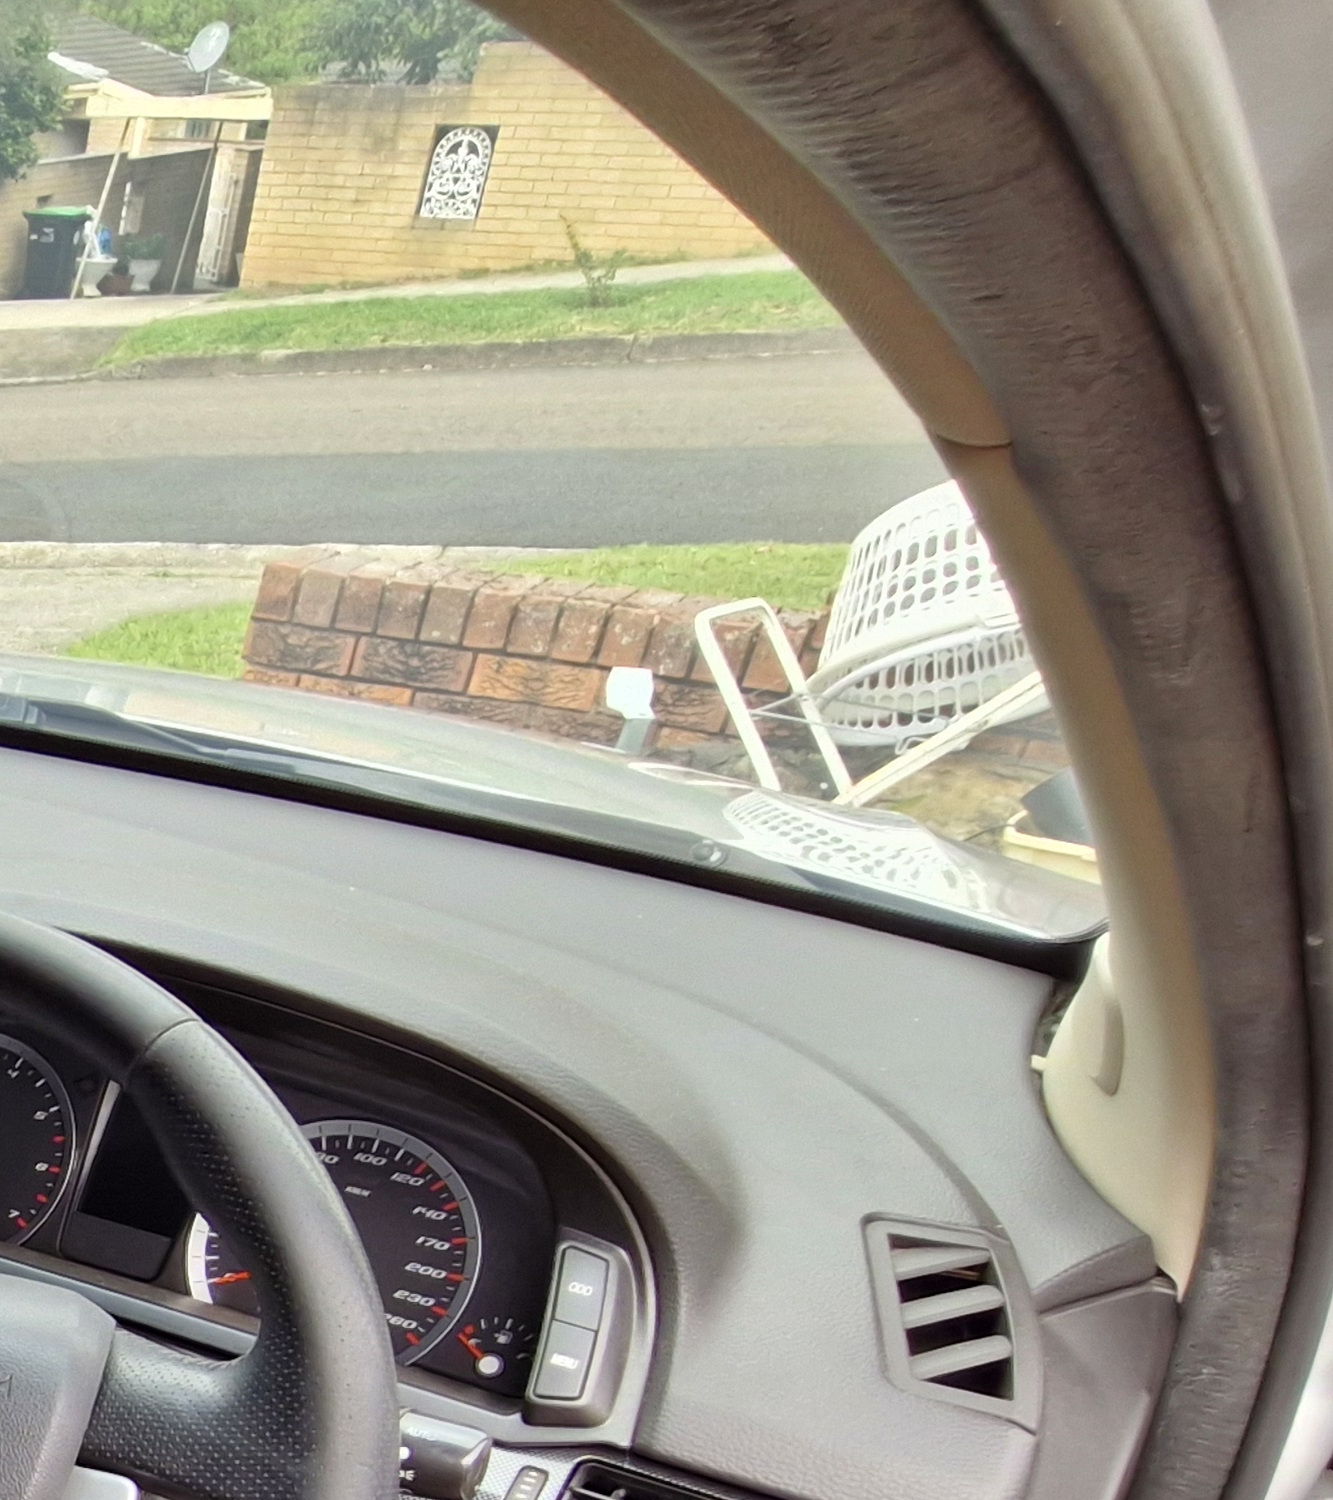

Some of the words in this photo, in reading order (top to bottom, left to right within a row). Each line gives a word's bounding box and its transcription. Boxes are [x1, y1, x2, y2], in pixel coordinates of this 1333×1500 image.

[353, 1152, 388, 1166] 100
[390, 1172, 425, 1186] 120
[413, 1206, 448, 1220] 140
[415, 1236, 450, 1251] 170
[404, 1262, 447, 1279] 200
[393, 1289, 436, 1307] 230
